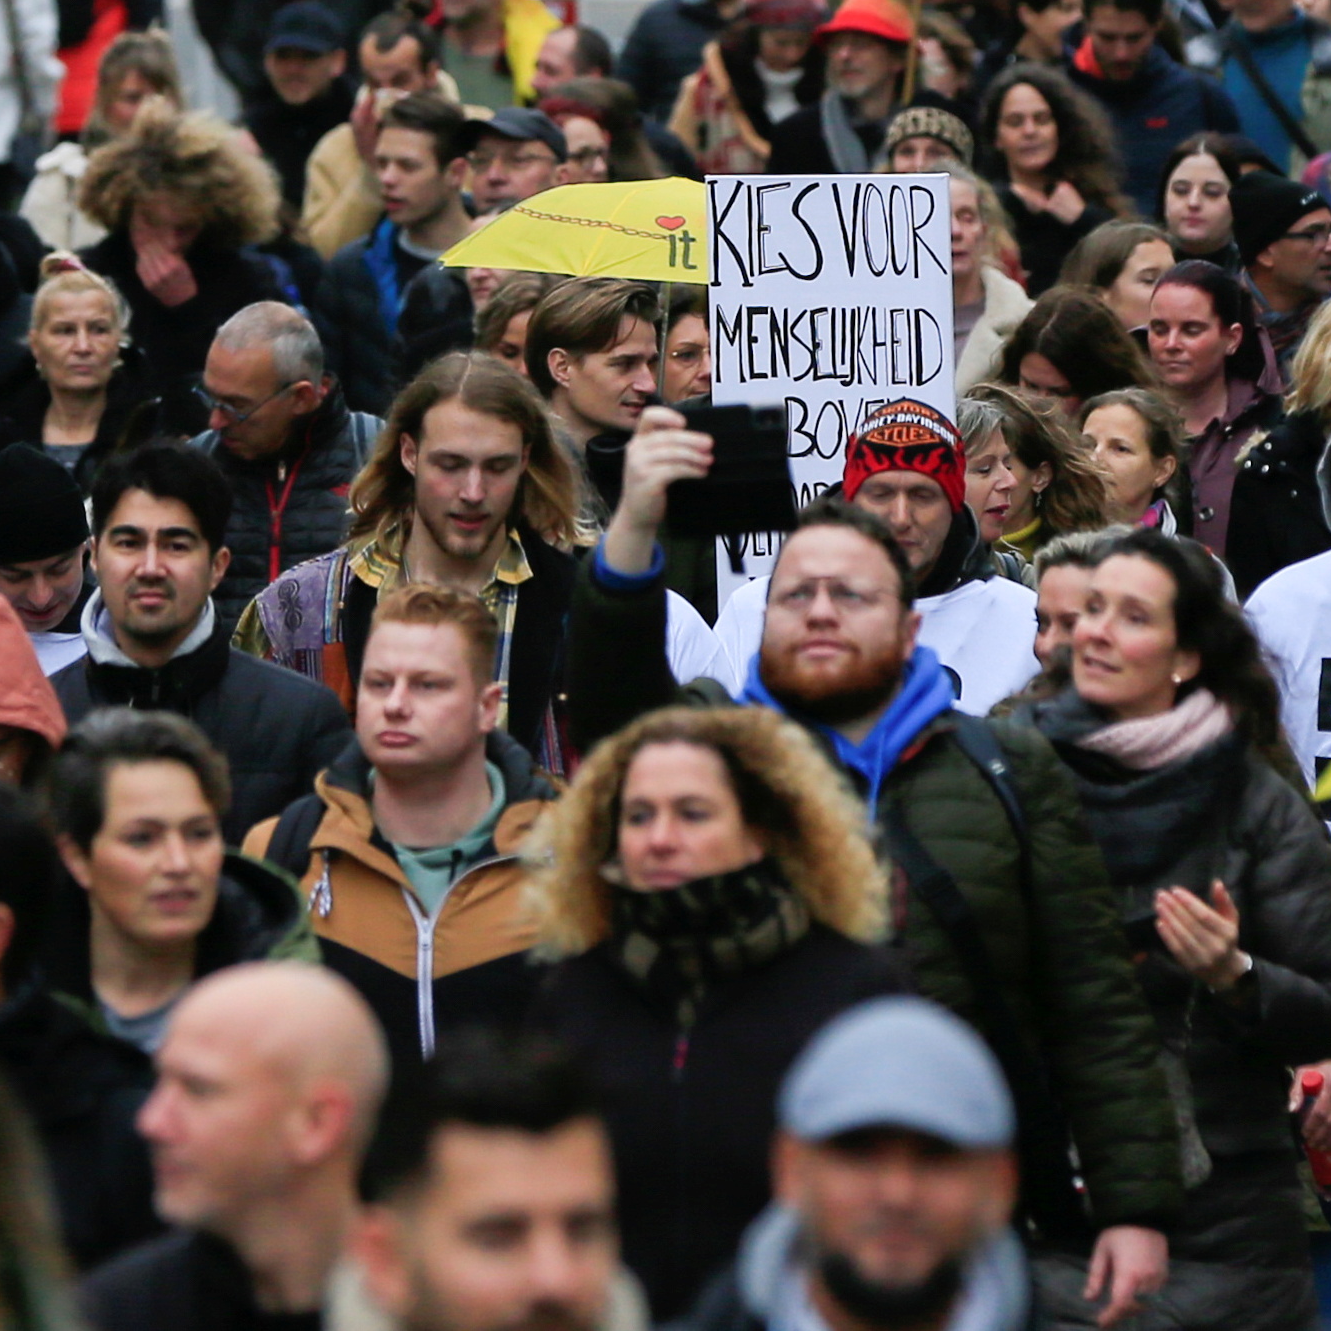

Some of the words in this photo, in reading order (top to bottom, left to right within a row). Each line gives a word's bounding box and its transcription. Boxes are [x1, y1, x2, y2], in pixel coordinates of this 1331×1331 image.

[707, 179, 824, 287] KIES
[831, 181, 948, 279] VOOR
[715, 302, 944, 388] MENSELIJKHEID
